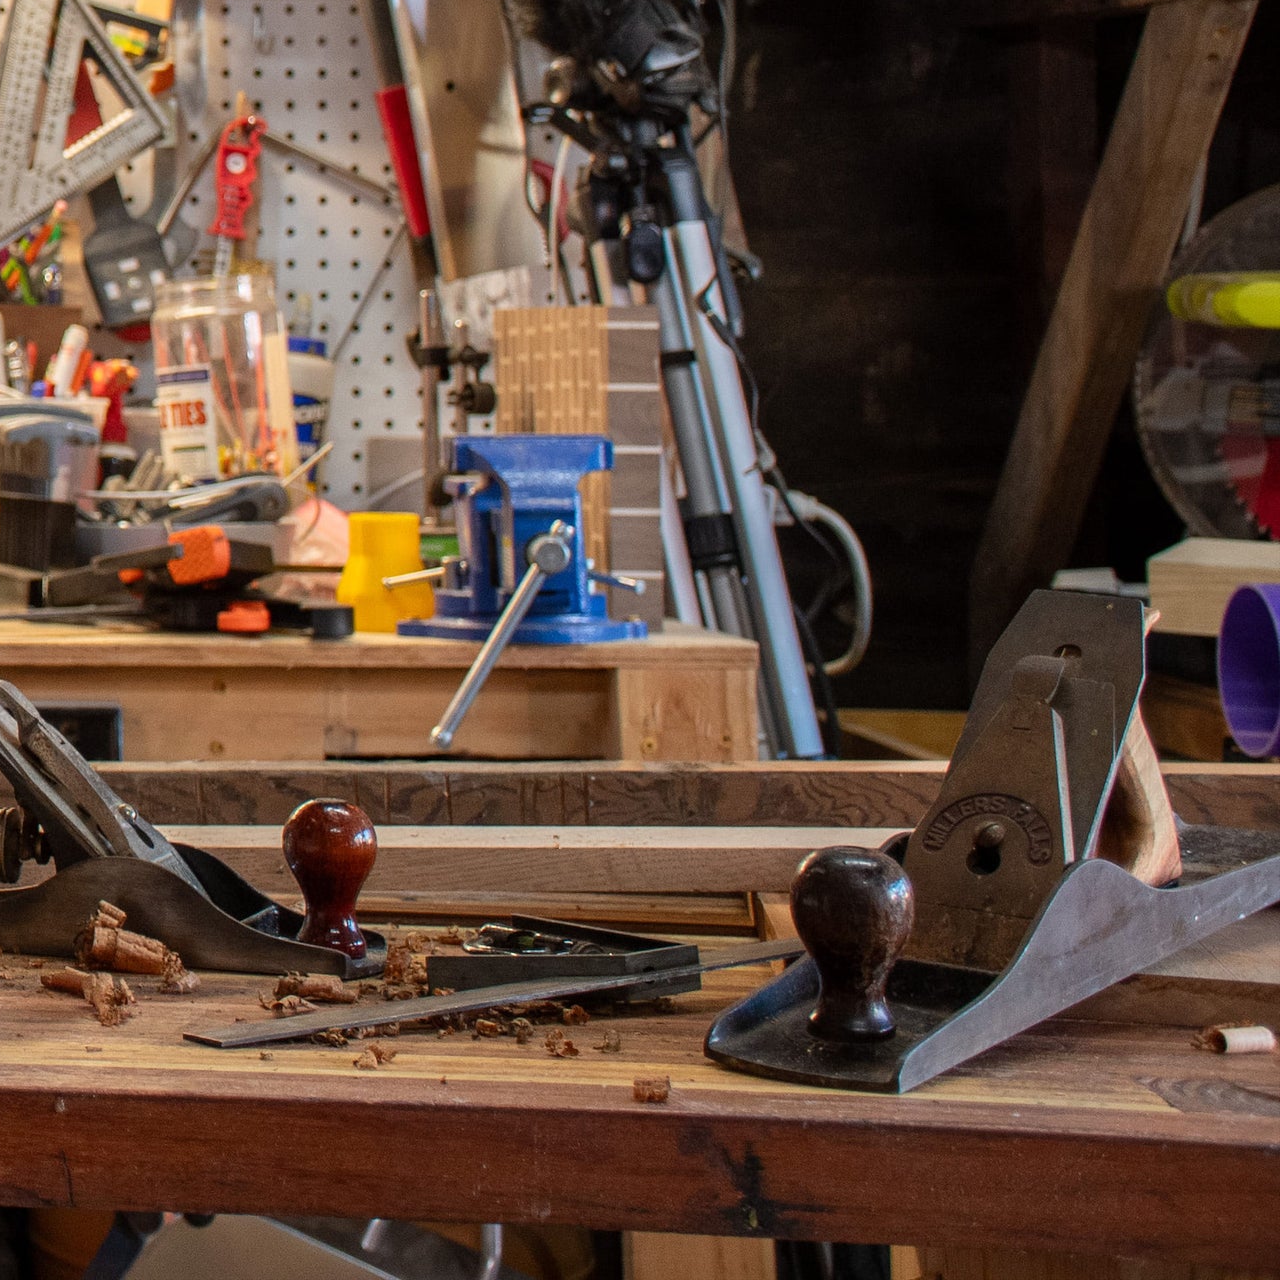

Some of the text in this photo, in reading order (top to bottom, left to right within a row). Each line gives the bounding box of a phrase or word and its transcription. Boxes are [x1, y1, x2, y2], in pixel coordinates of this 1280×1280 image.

[172, 400, 207, 427] TIES
[923, 795, 1052, 863] MILLERS FALLS
